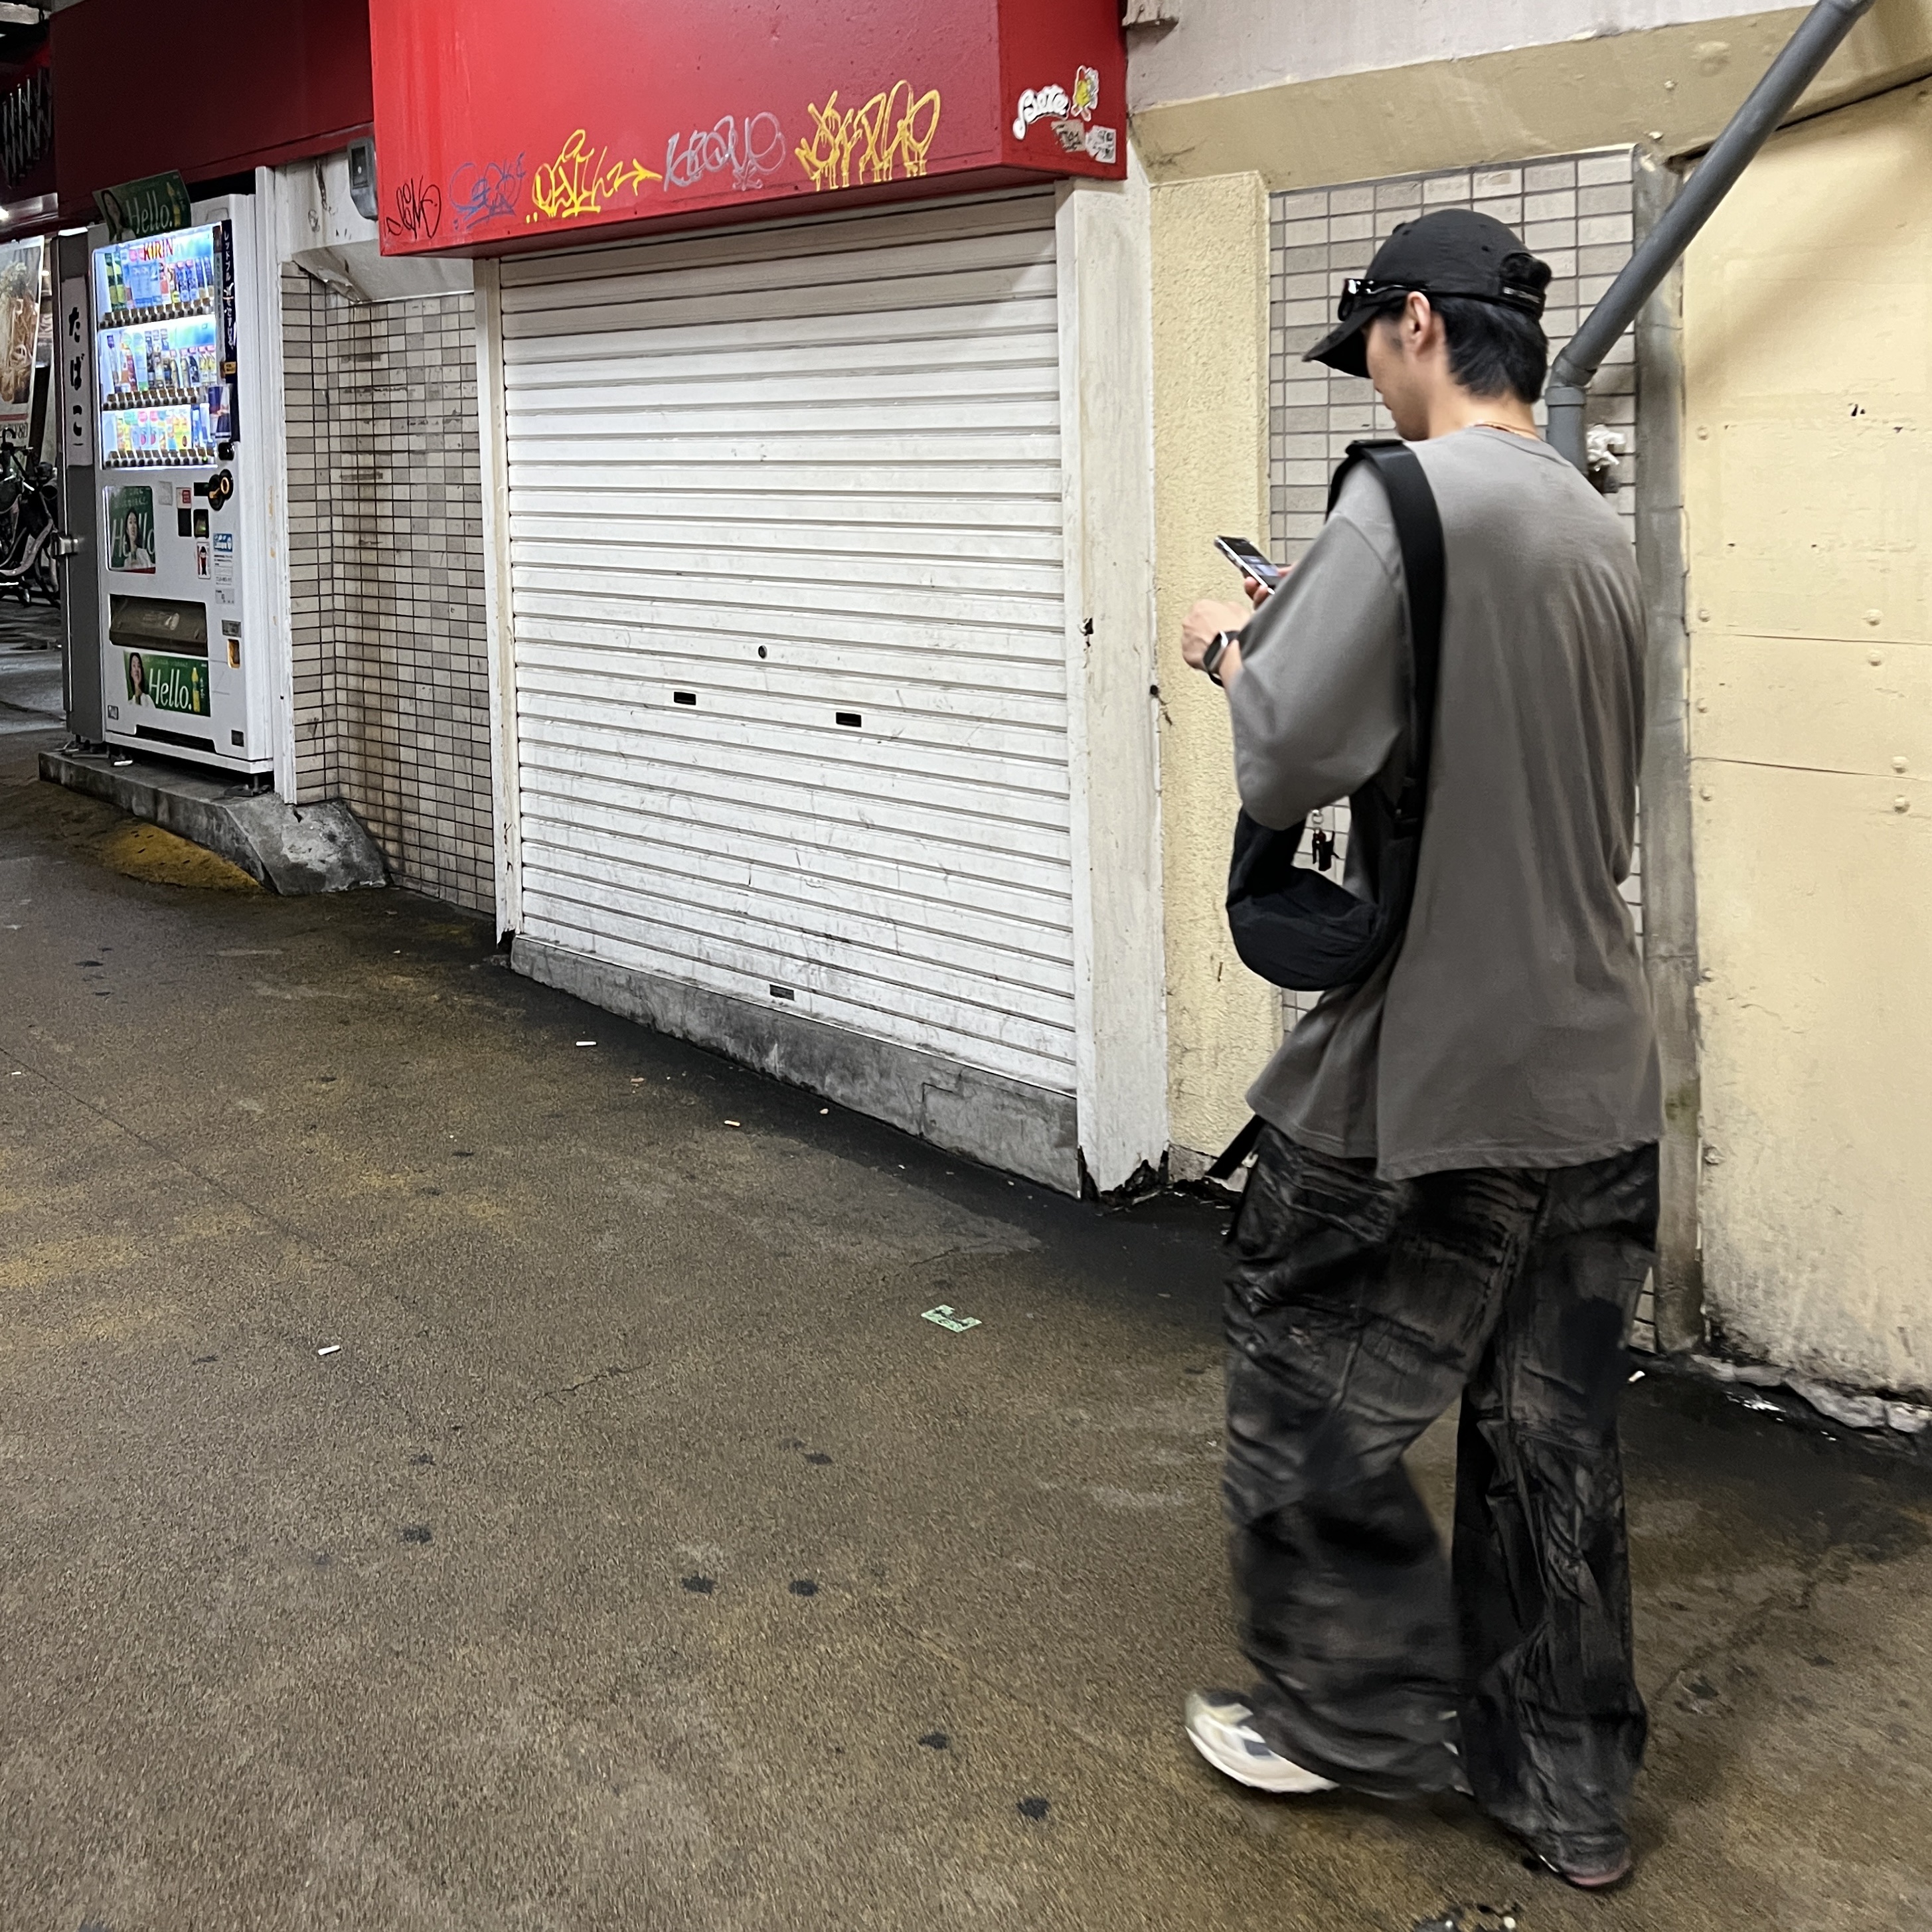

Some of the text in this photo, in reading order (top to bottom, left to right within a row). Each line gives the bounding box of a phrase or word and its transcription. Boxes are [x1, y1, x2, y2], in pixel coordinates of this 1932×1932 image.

[125, 189, 173, 234] Hello.
[143, 238, 174, 261] KIRIN
[68, 307, 85, 438] たばこ
[149, 668, 192, 710] Hello.
